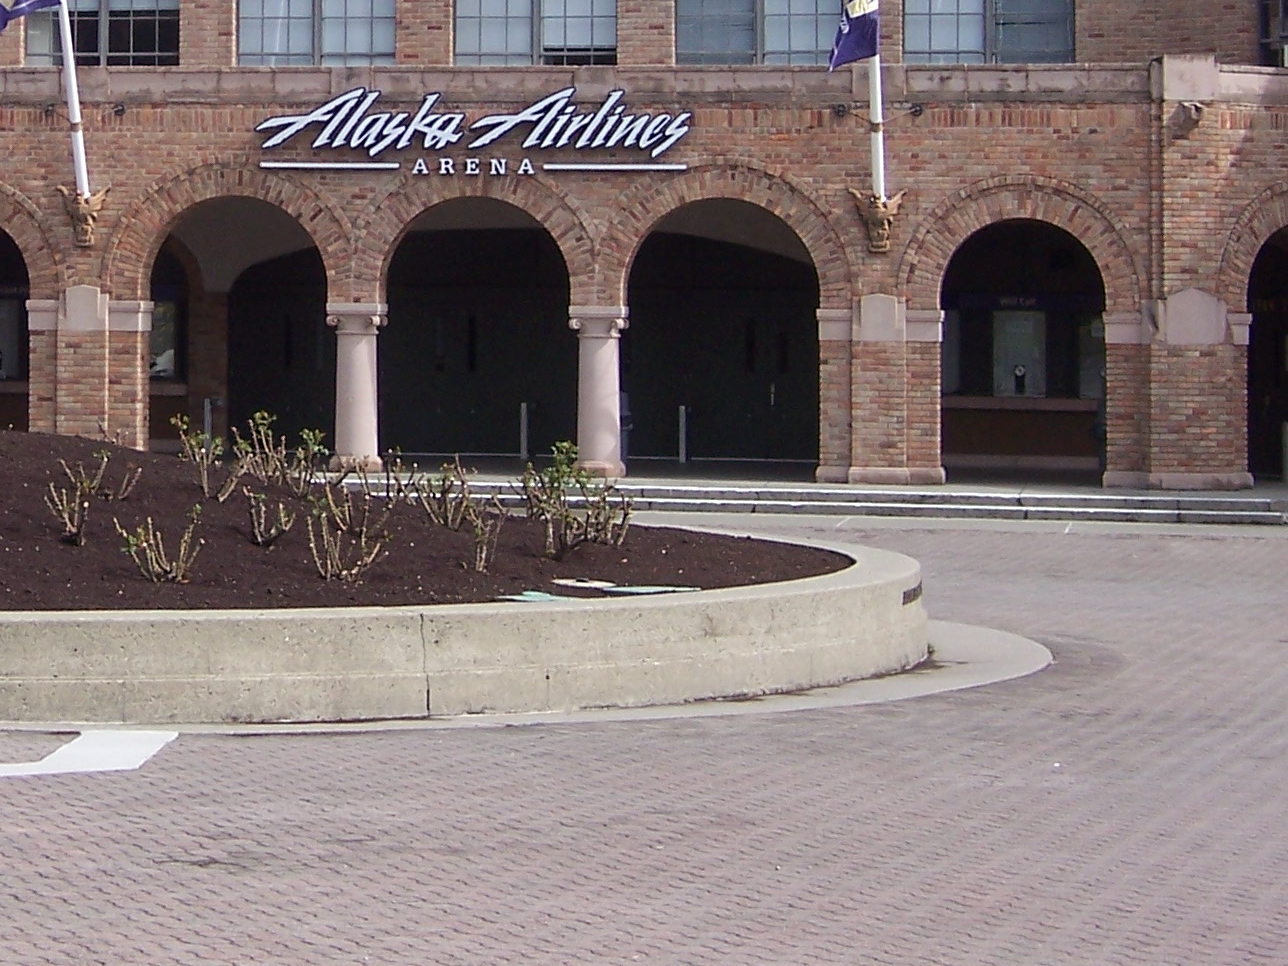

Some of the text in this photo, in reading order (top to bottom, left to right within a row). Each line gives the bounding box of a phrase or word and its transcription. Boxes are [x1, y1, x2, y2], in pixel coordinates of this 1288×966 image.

[255, 86, 692, 158] Alaska Airlines
[412, 157, 535, 175] ARENA
